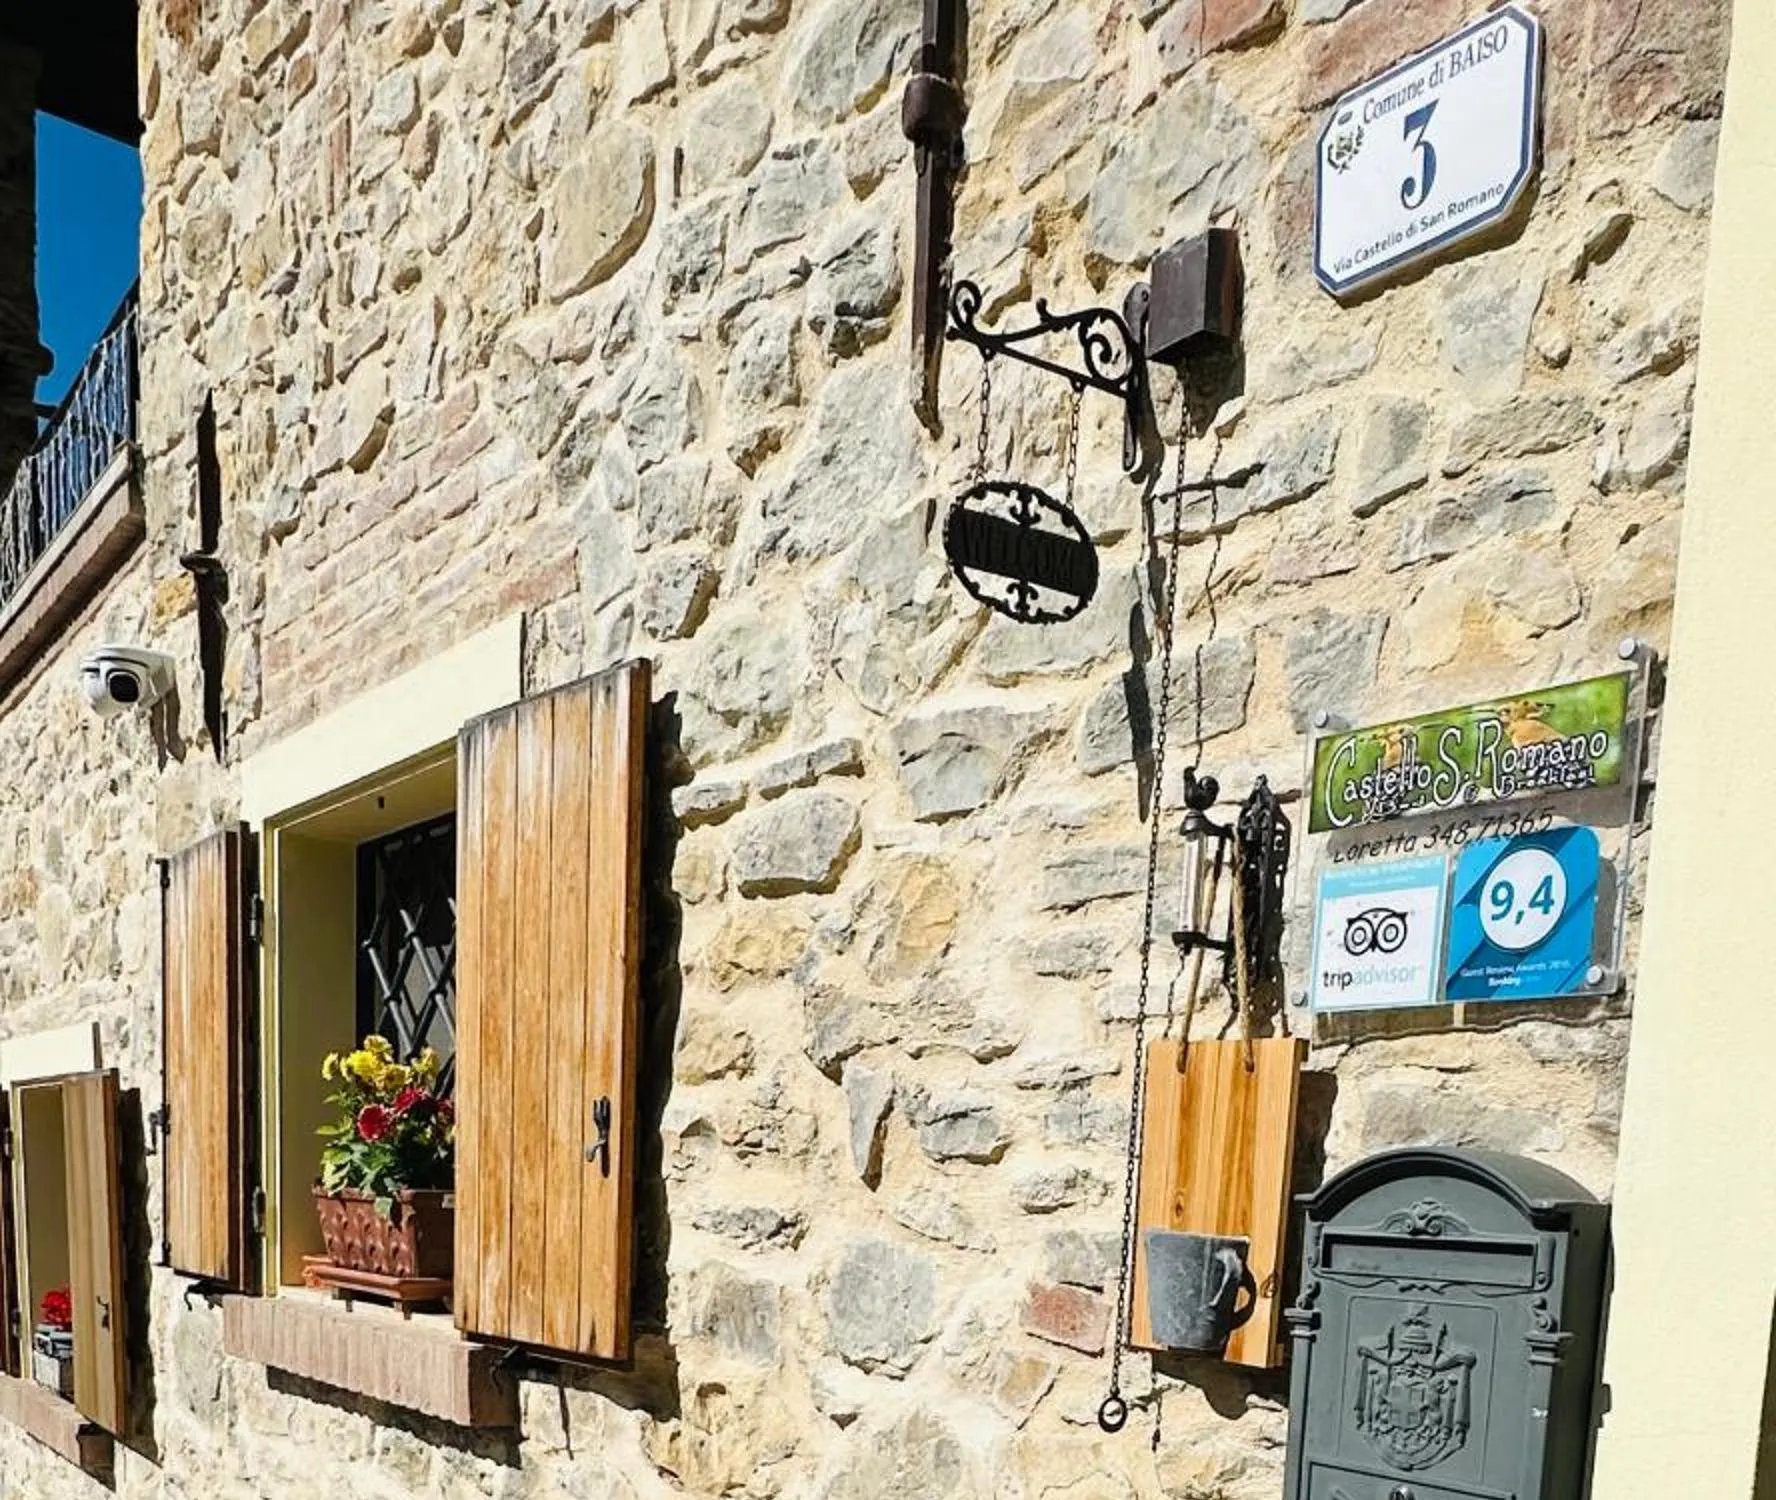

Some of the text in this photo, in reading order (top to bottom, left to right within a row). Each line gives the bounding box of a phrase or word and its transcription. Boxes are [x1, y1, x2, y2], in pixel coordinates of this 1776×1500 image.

[1363, 25, 1509, 124] Comune di BAISO
[1400, 98, 1440, 210] 3
[1333, 183, 1505, 274] Via Castello di San Romano
[1325, 732, 1432, 827] Castello
[1477, 718, 1609, 798] Romano
[1334, 838, 1417, 864] Loretta
[1490, 874, 1555, 926] 9,4
[1323, 962, 1417, 991] tripadvisor
